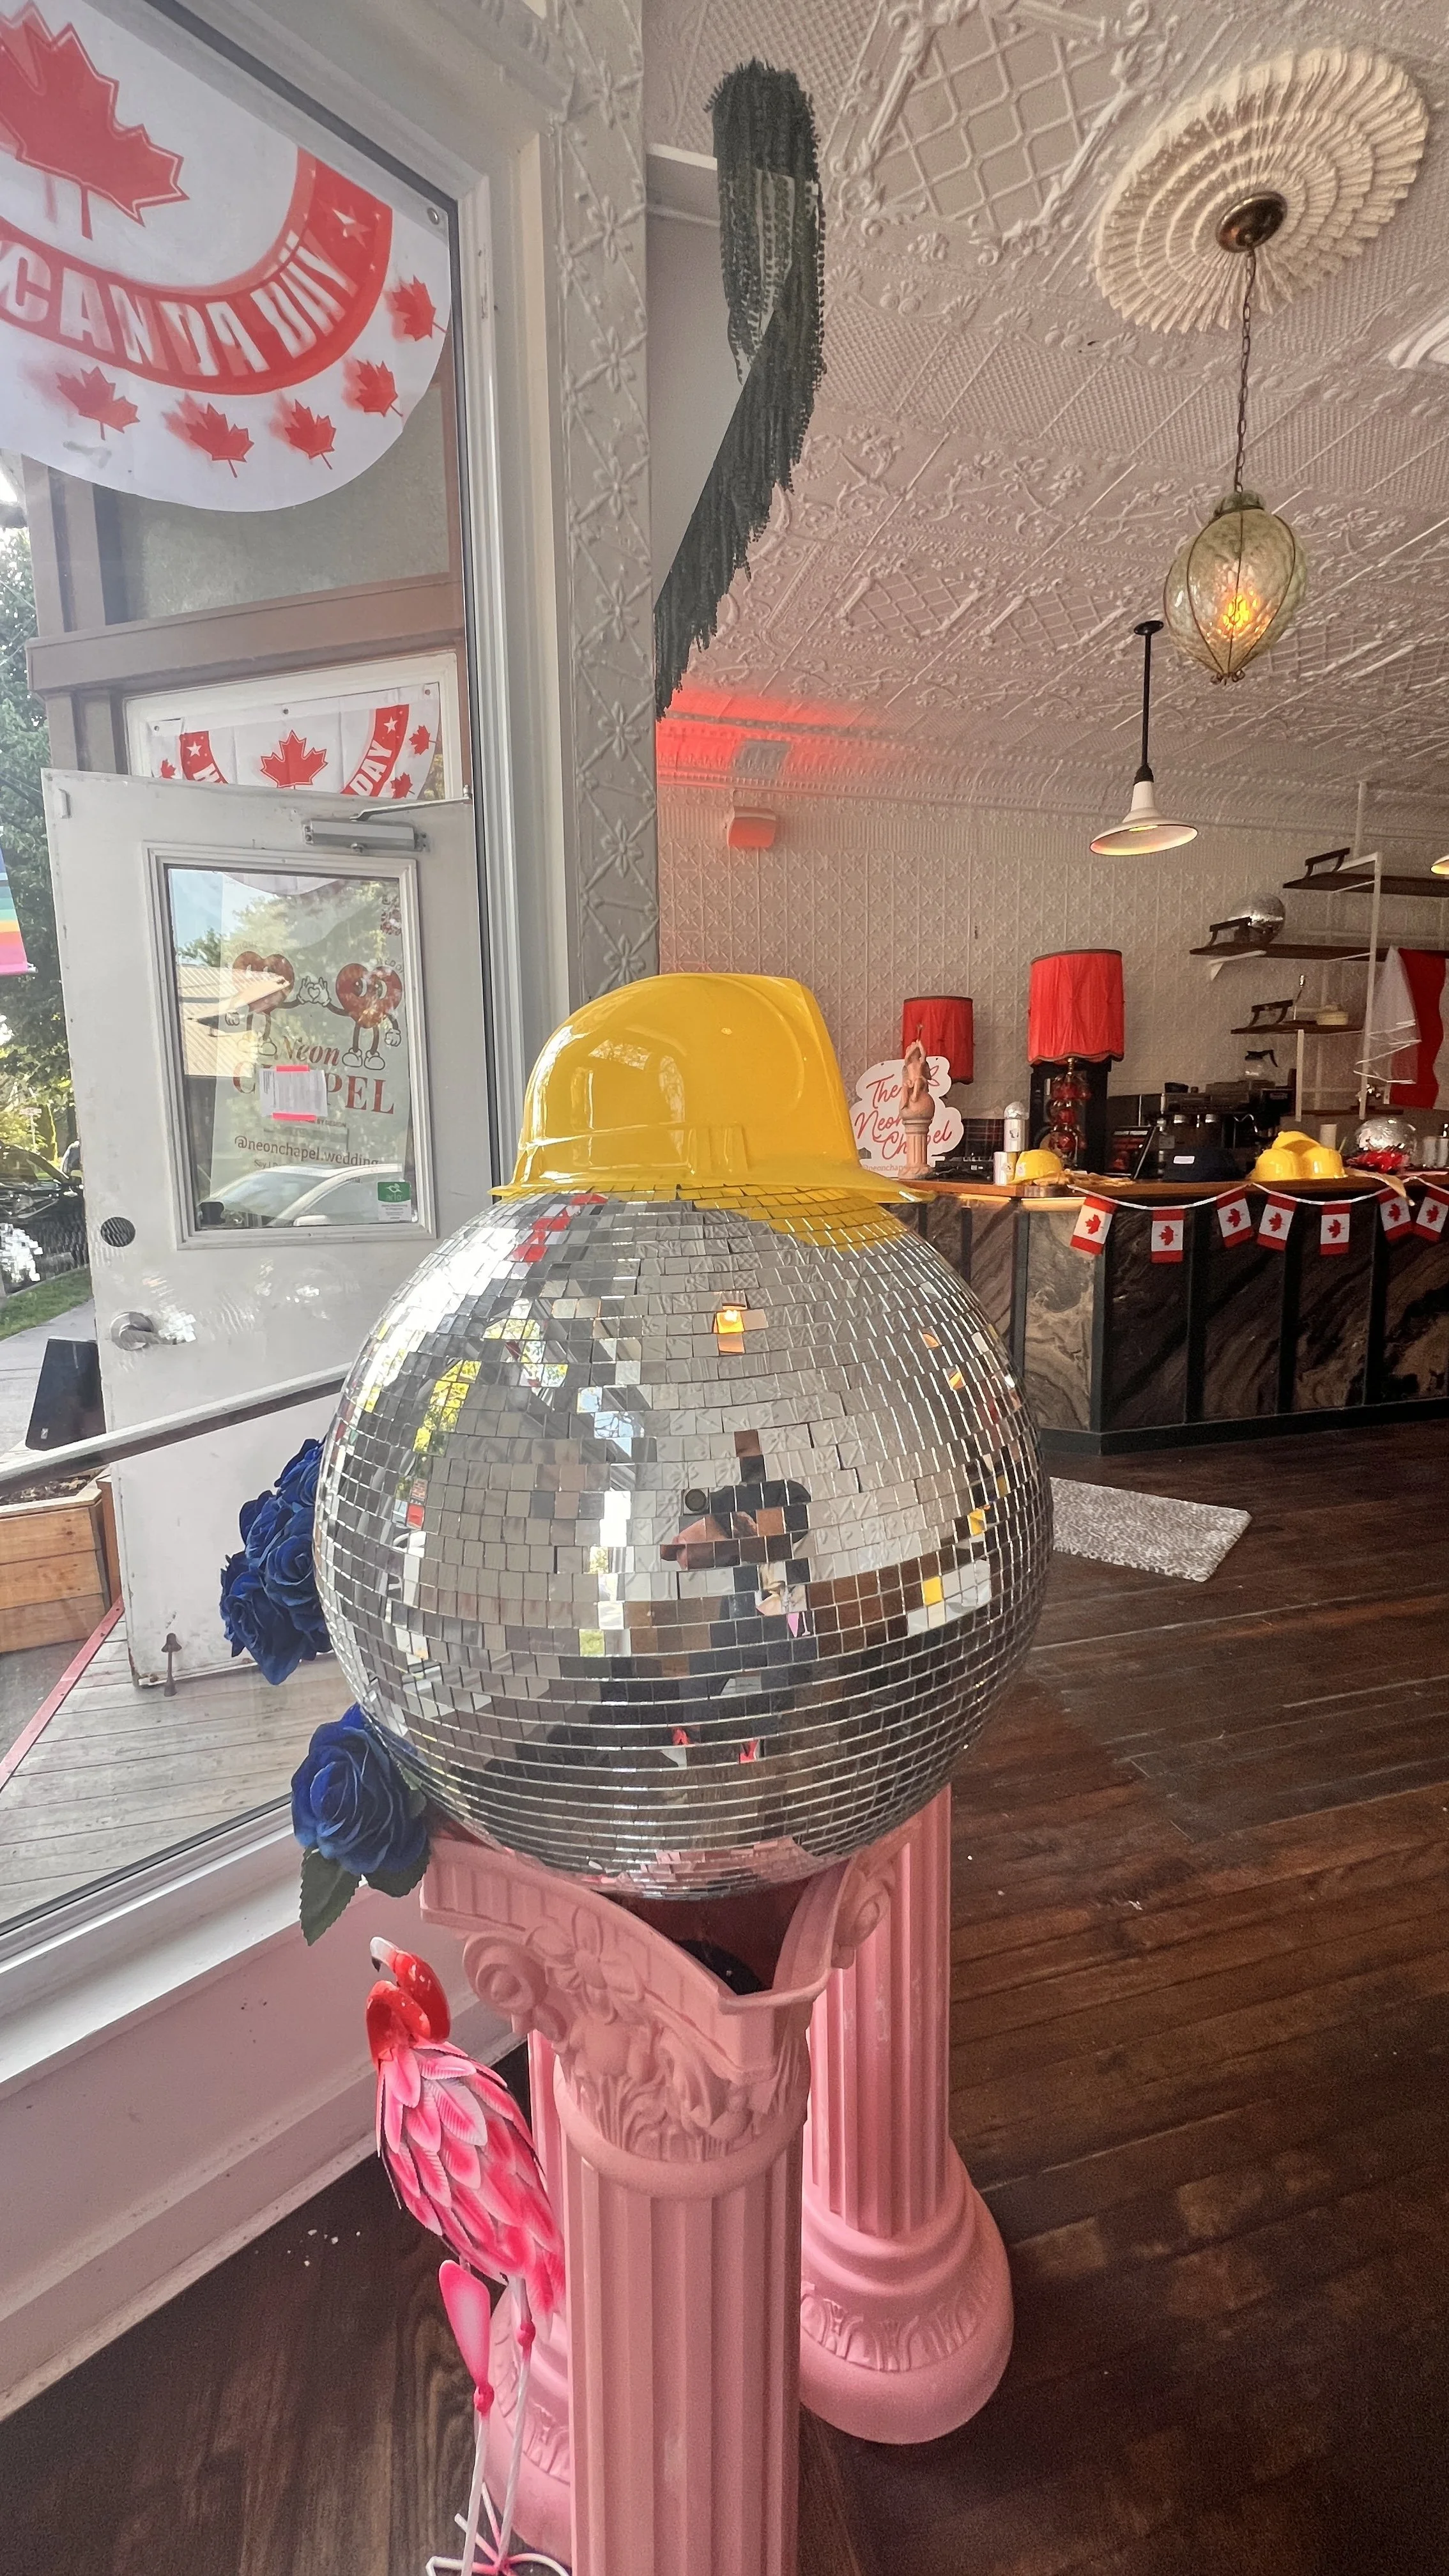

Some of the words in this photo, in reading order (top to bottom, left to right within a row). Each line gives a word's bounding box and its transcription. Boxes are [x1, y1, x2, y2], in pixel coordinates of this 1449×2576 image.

[349, 740, 392, 796] DAY
[275, 1036, 340, 1066] Neon
[233, 1061, 394, 1114] CPEL
[866, 1074, 903, 1109] The
[234, 1135, 378, 1165] @neonchapel.wedding
